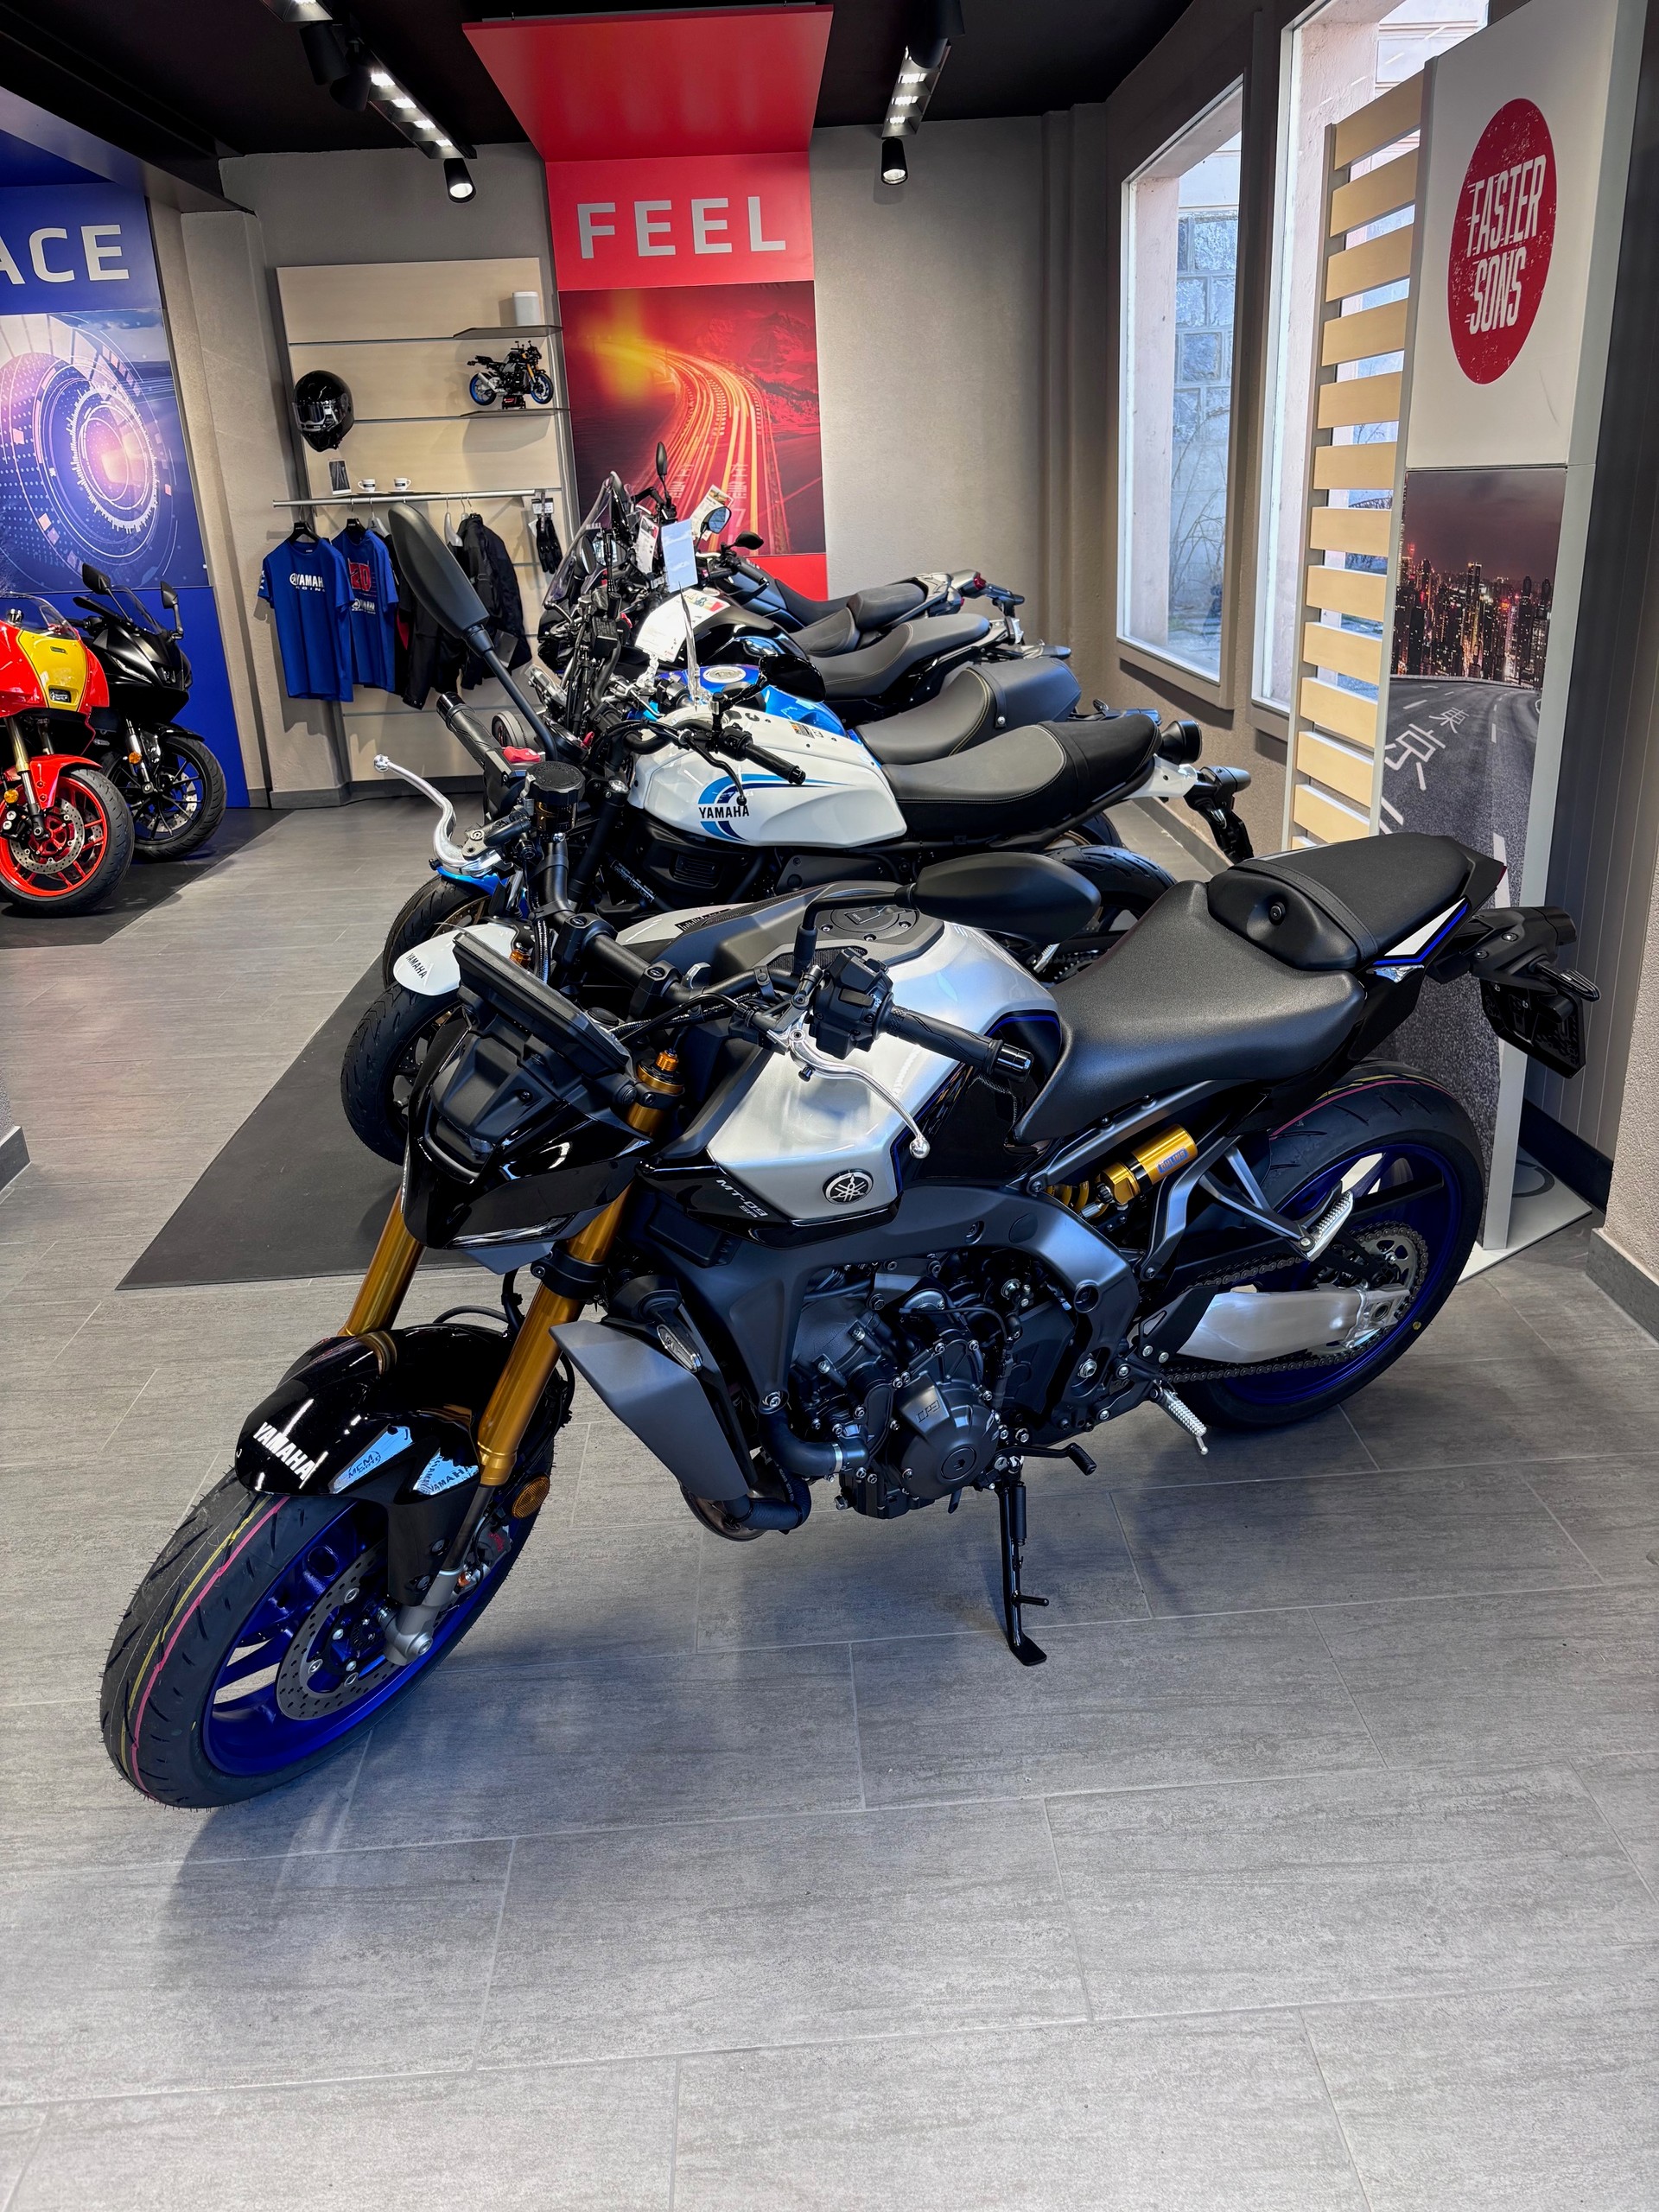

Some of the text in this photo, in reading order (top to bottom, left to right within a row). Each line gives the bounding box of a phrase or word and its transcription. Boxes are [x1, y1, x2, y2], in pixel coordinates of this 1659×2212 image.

[1466, 155, 1547, 257] FASTER
[577, 196, 786, 259] FEEL
[1469, 246, 1527, 334] SONS
[296, 574, 324, 588] YAMAH
[347, 557, 372, 591] 20
[698, 805, 750, 819] YAMAHA
[406, 952, 428, 979] YAMAHA
[716, 1179, 768, 1217] MT-09
[739, 1205, 758, 1217] SP
[252, 1422, 316, 1481] YAMAHA
[348, 1453, 373, 1479] MCM
